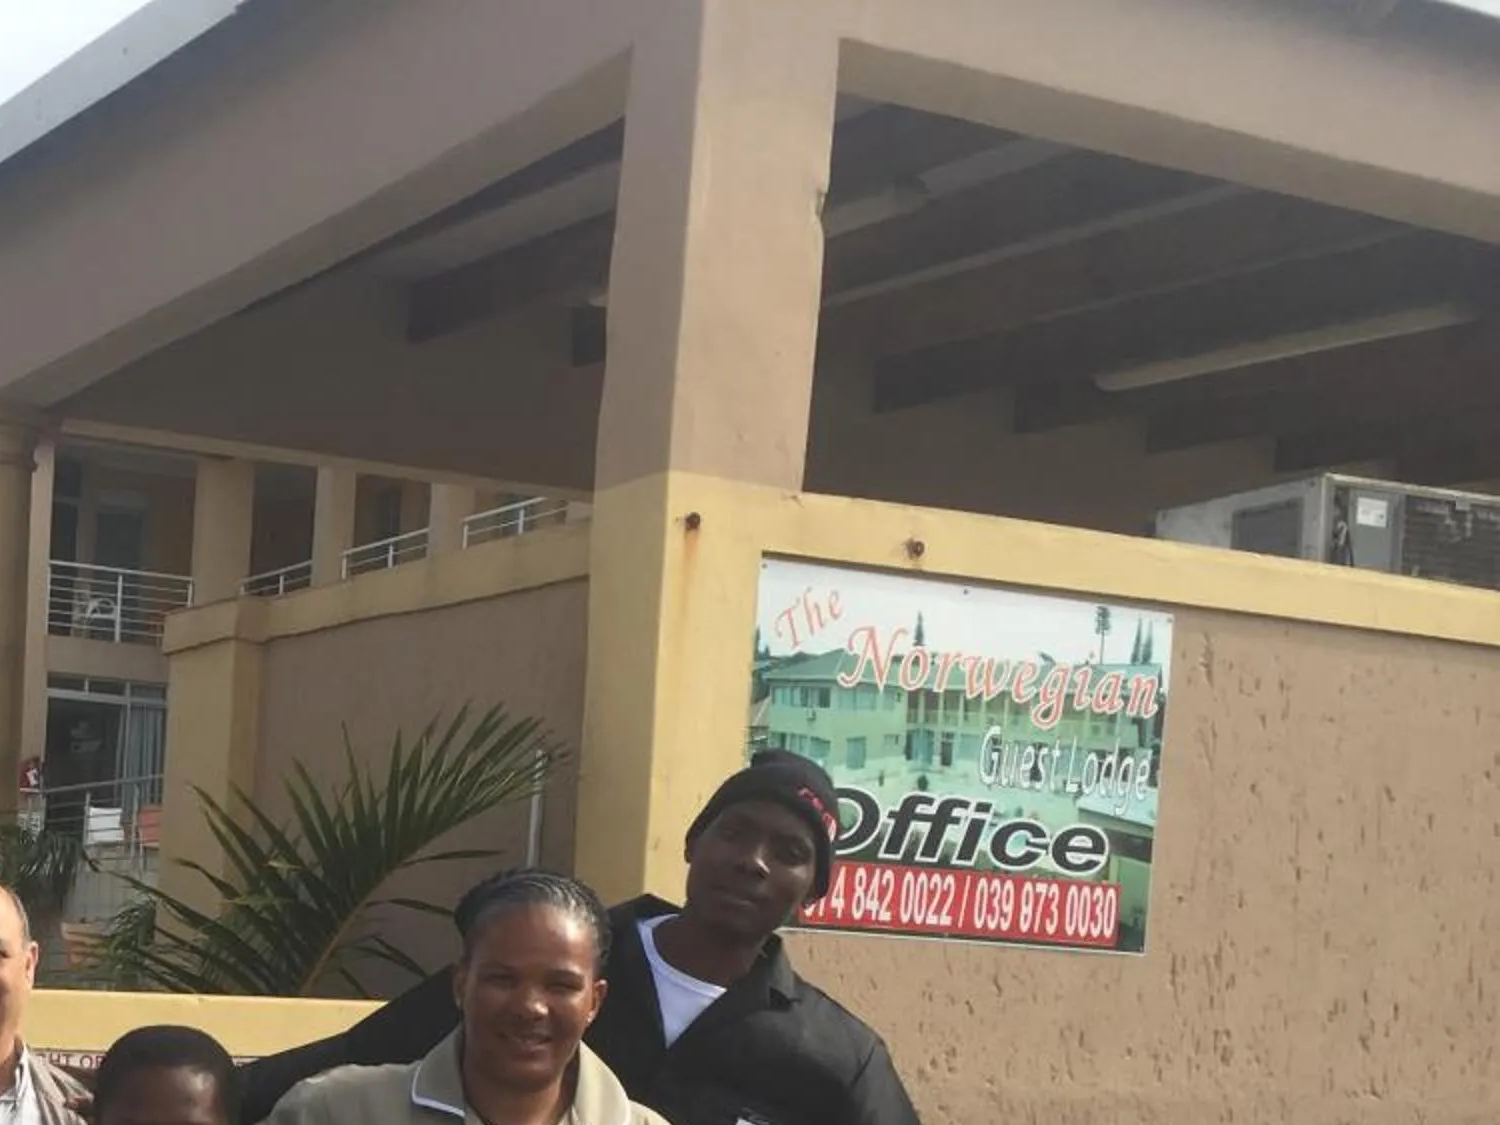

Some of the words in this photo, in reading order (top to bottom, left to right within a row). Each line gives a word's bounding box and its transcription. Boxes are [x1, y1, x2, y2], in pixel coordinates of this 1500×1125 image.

[773, 585, 843, 649] The
[836, 624, 1160, 730] Norwegian
[979, 724, 1061, 792] Guest
[1065, 734, 1154, 816] Lodge
[834, 785, 1110, 876] Office
[851, 866, 896, 922] 842
[900, 870, 956, 926] 0022
[973, 876, 1015, 932] 039
[1064, 883, 1118, 939] 0030
